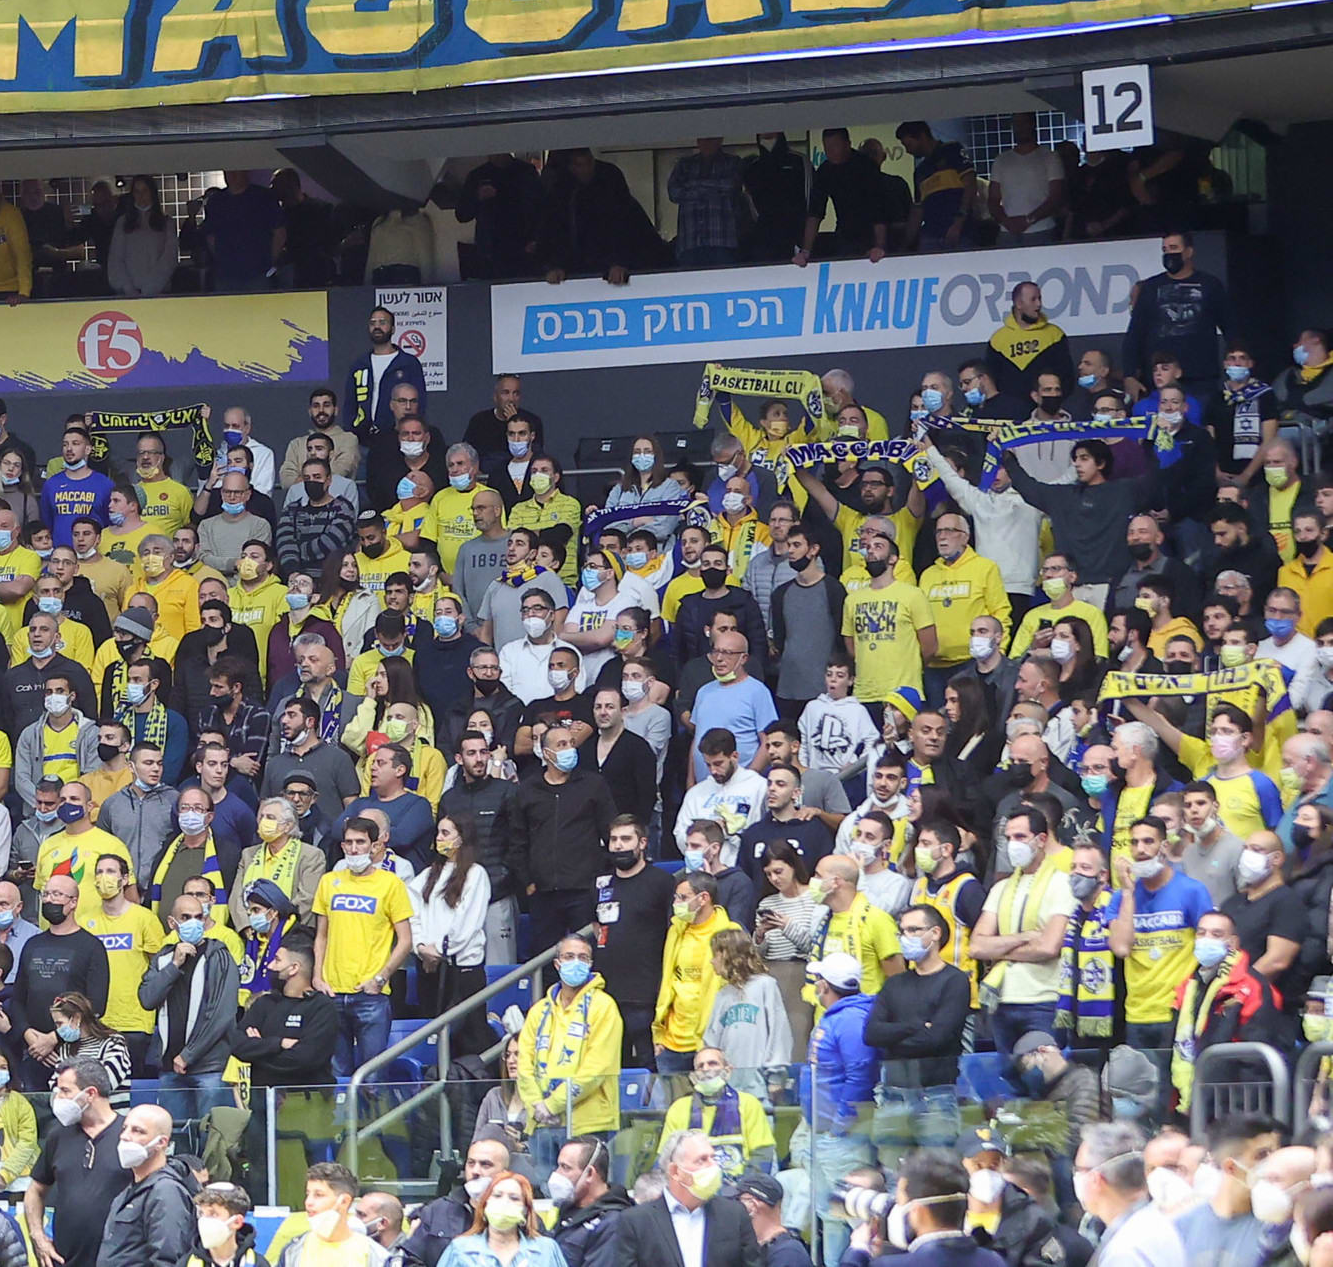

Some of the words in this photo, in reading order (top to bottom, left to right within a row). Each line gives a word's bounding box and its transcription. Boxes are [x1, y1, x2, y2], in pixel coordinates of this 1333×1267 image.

[1090, 81, 1143, 135] 12
[377, 291, 405, 310] לעשן
[407, 292, 443, 304] אסור
[644, 300, 713, 342] חזק
[727, 294, 784, 330] הכי
[532, 308, 628, 344] בגבס.
[79, 318, 142, 370] f5
[1009, 339, 1040, 357] 1932
[713, 374, 781, 392] BASKETBALL
[787, 440, 920, 466] MACCABI
[54, 492, 95, 502] MACCABI
[55, 504, 72, 514] TEL
[74, 504, 93, 514] AVIV
[855, 603, 876, 615] NOW
[878, 602, 897, 614] I'M
[855, 615, 896, 633] BACK
[333, 895, 373, 912] FOX
